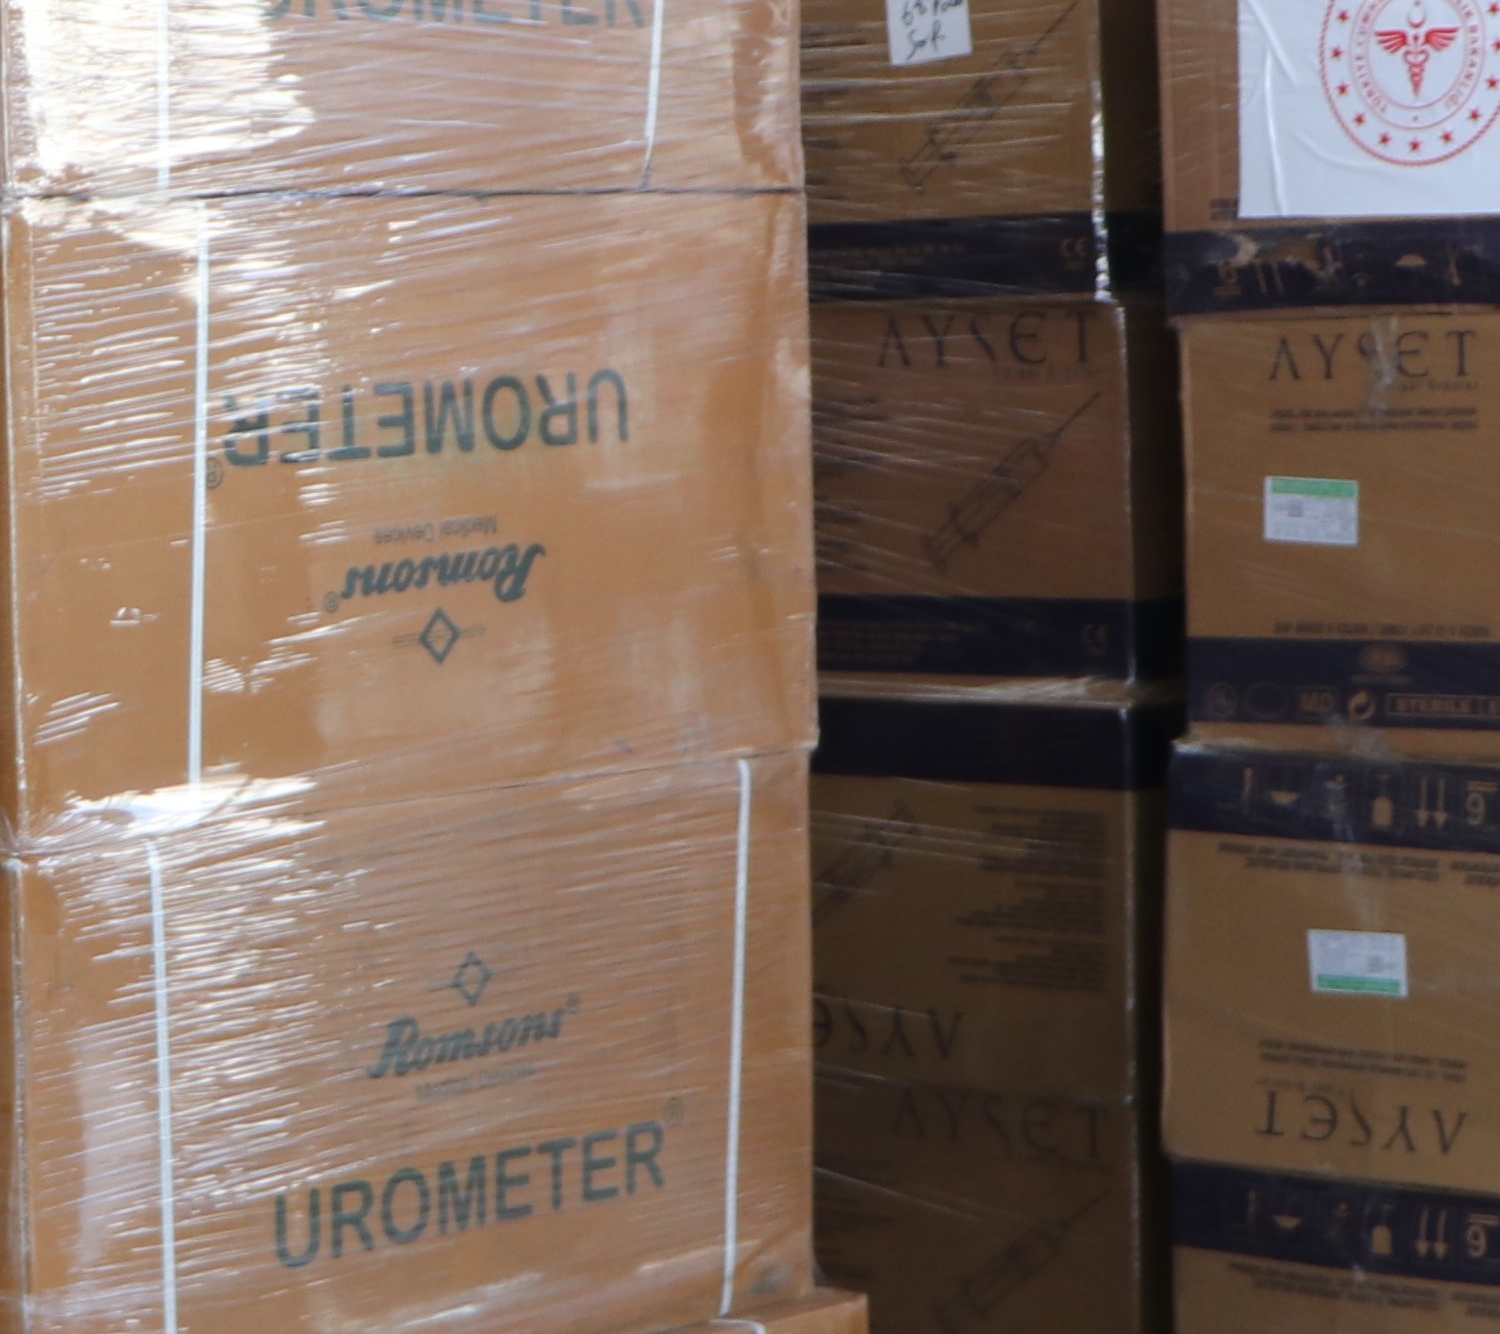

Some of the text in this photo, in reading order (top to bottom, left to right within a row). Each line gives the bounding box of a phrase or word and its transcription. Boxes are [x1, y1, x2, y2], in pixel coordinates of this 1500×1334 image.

[219, 368, 630, 467] UROMETER
[366, 1004, 567, 1079] Romsons
[1256, 1088, 1469, 1157] AYSET
[272, 1117, 666, 1269] UROMETER
